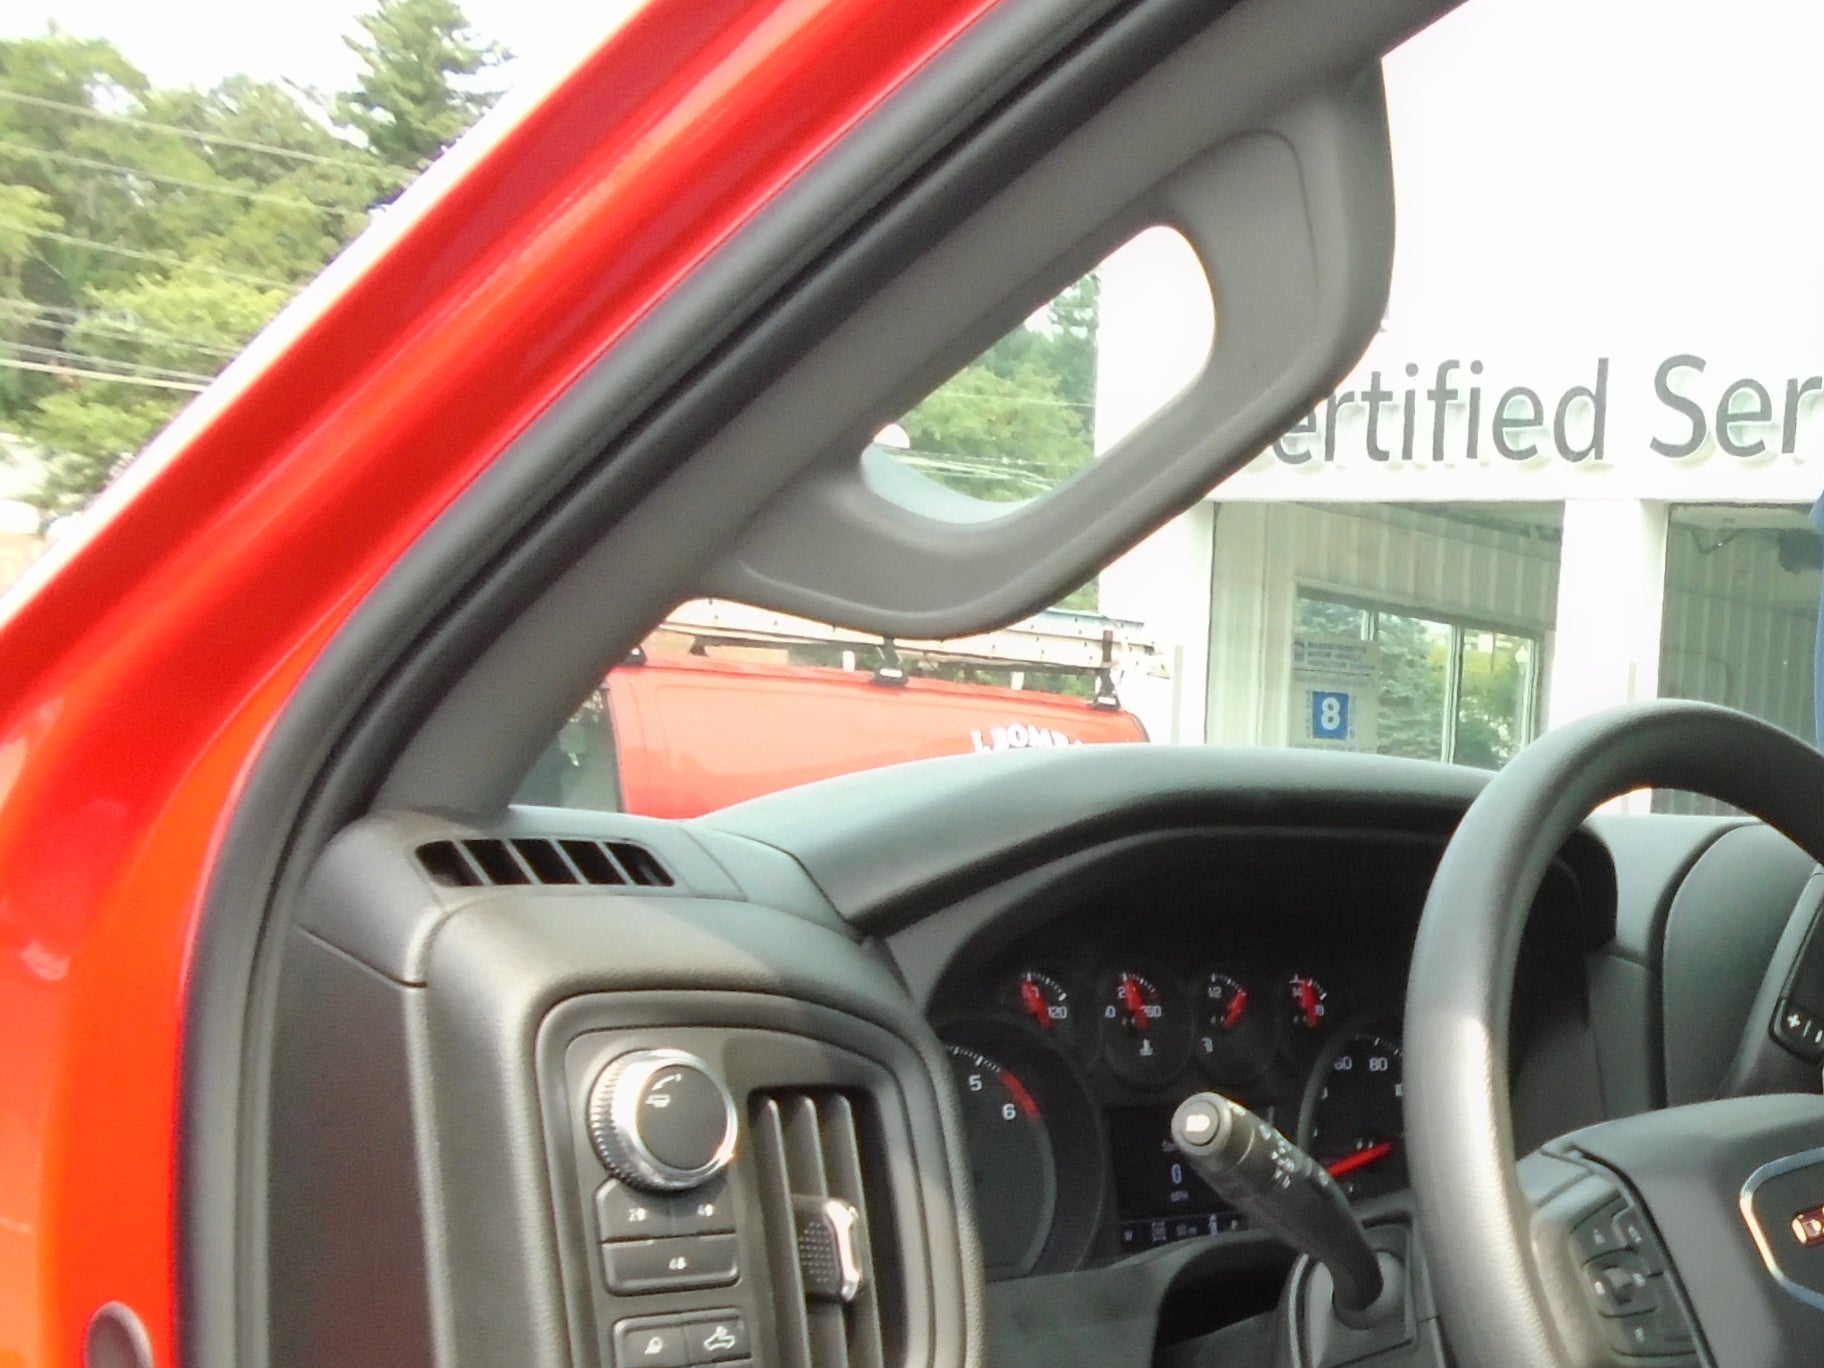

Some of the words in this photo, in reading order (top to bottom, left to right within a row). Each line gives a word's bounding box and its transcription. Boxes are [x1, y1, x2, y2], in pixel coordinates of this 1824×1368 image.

[1272, 357, 1609, 465] ertified
[1320, 696, 1341, 731] 8
[968, 1074, 983, 1092] 5
[1002, 1103, 1017, 1121] 6
